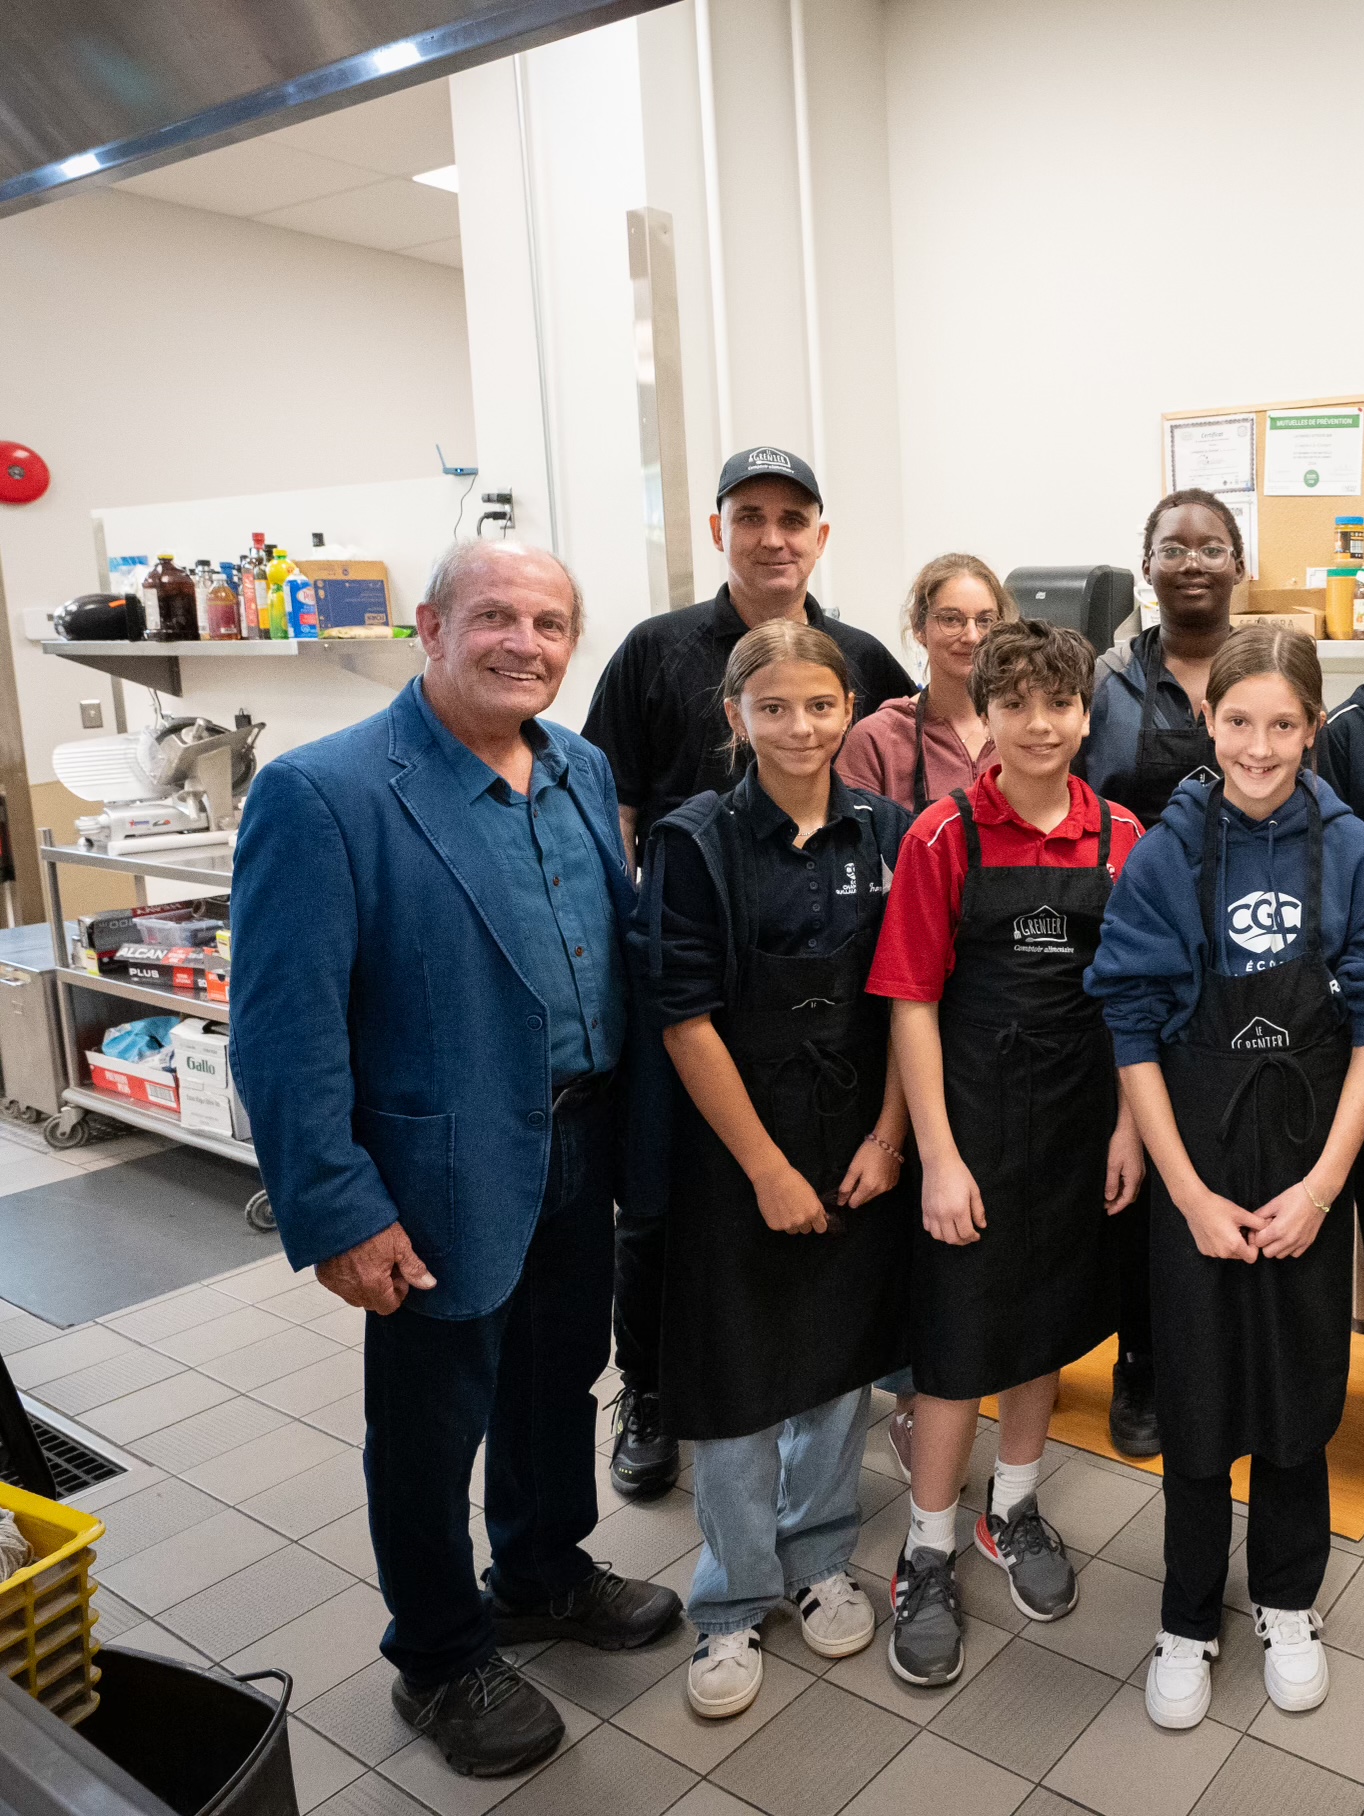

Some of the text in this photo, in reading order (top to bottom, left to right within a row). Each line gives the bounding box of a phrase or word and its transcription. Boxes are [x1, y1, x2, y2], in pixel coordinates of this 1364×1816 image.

[753, 453, 786, 463] GRENIER
[1227, 898, 1302, 935] CGC
[1020, 917, 1062, 935] GRENIER
[115, 948, 167, 959] ALCAN
[1245, 959, 1284, 972] ÉCO
[129, 968, 159, 978] PLUS
[1256, 1026, 1263, 1036] LE
[186, 1056, 216, 1075] Gallo
